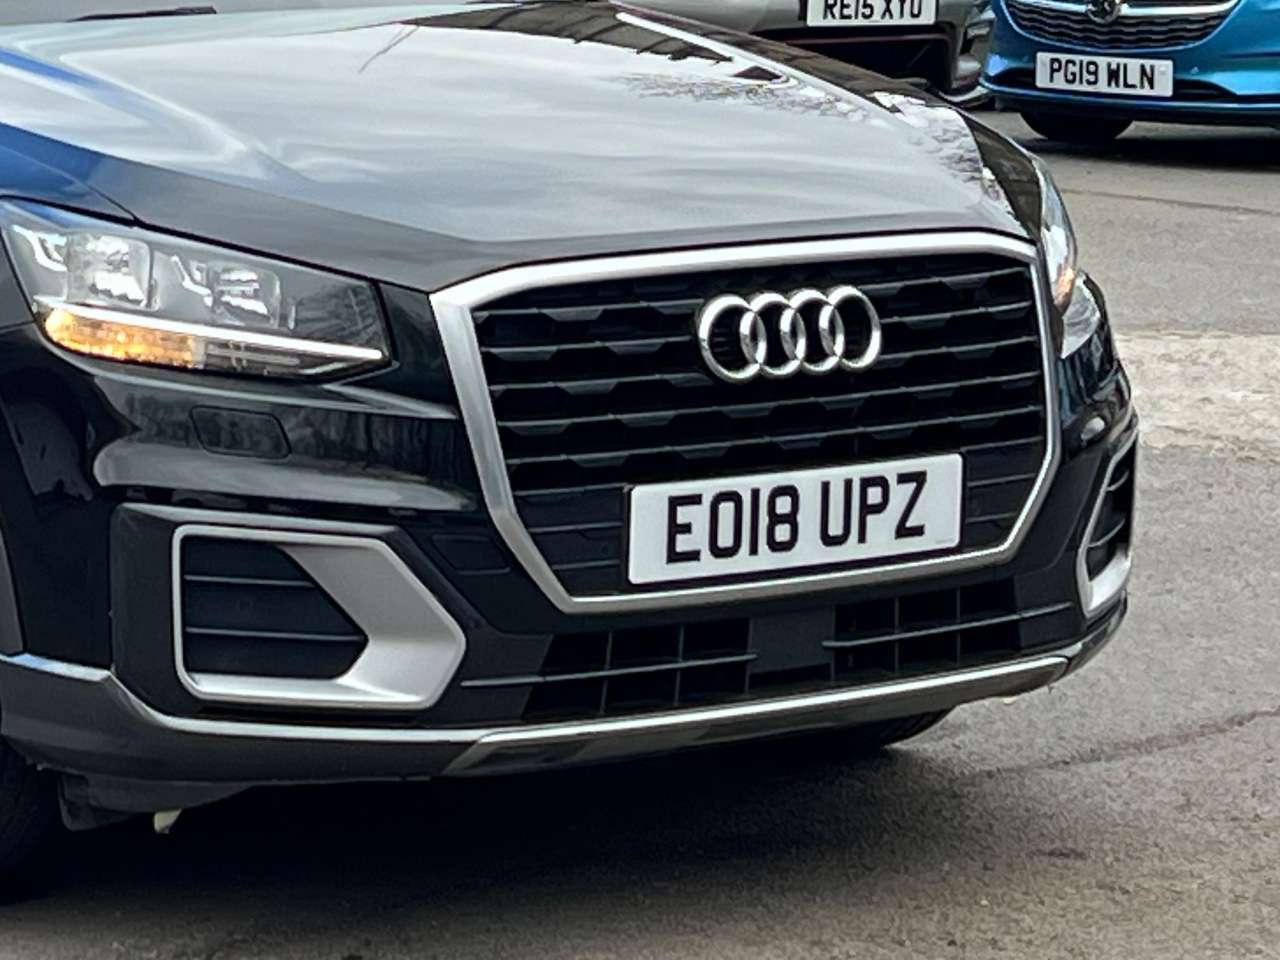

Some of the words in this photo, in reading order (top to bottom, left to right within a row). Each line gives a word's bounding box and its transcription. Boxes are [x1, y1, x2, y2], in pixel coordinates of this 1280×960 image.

[1049, 57, 1099, 86] PG19
[1106, 61, 1155, 90] WLN
[666, 485, 800, 565] EO18
[819, 471, 928, 547] UPZ
